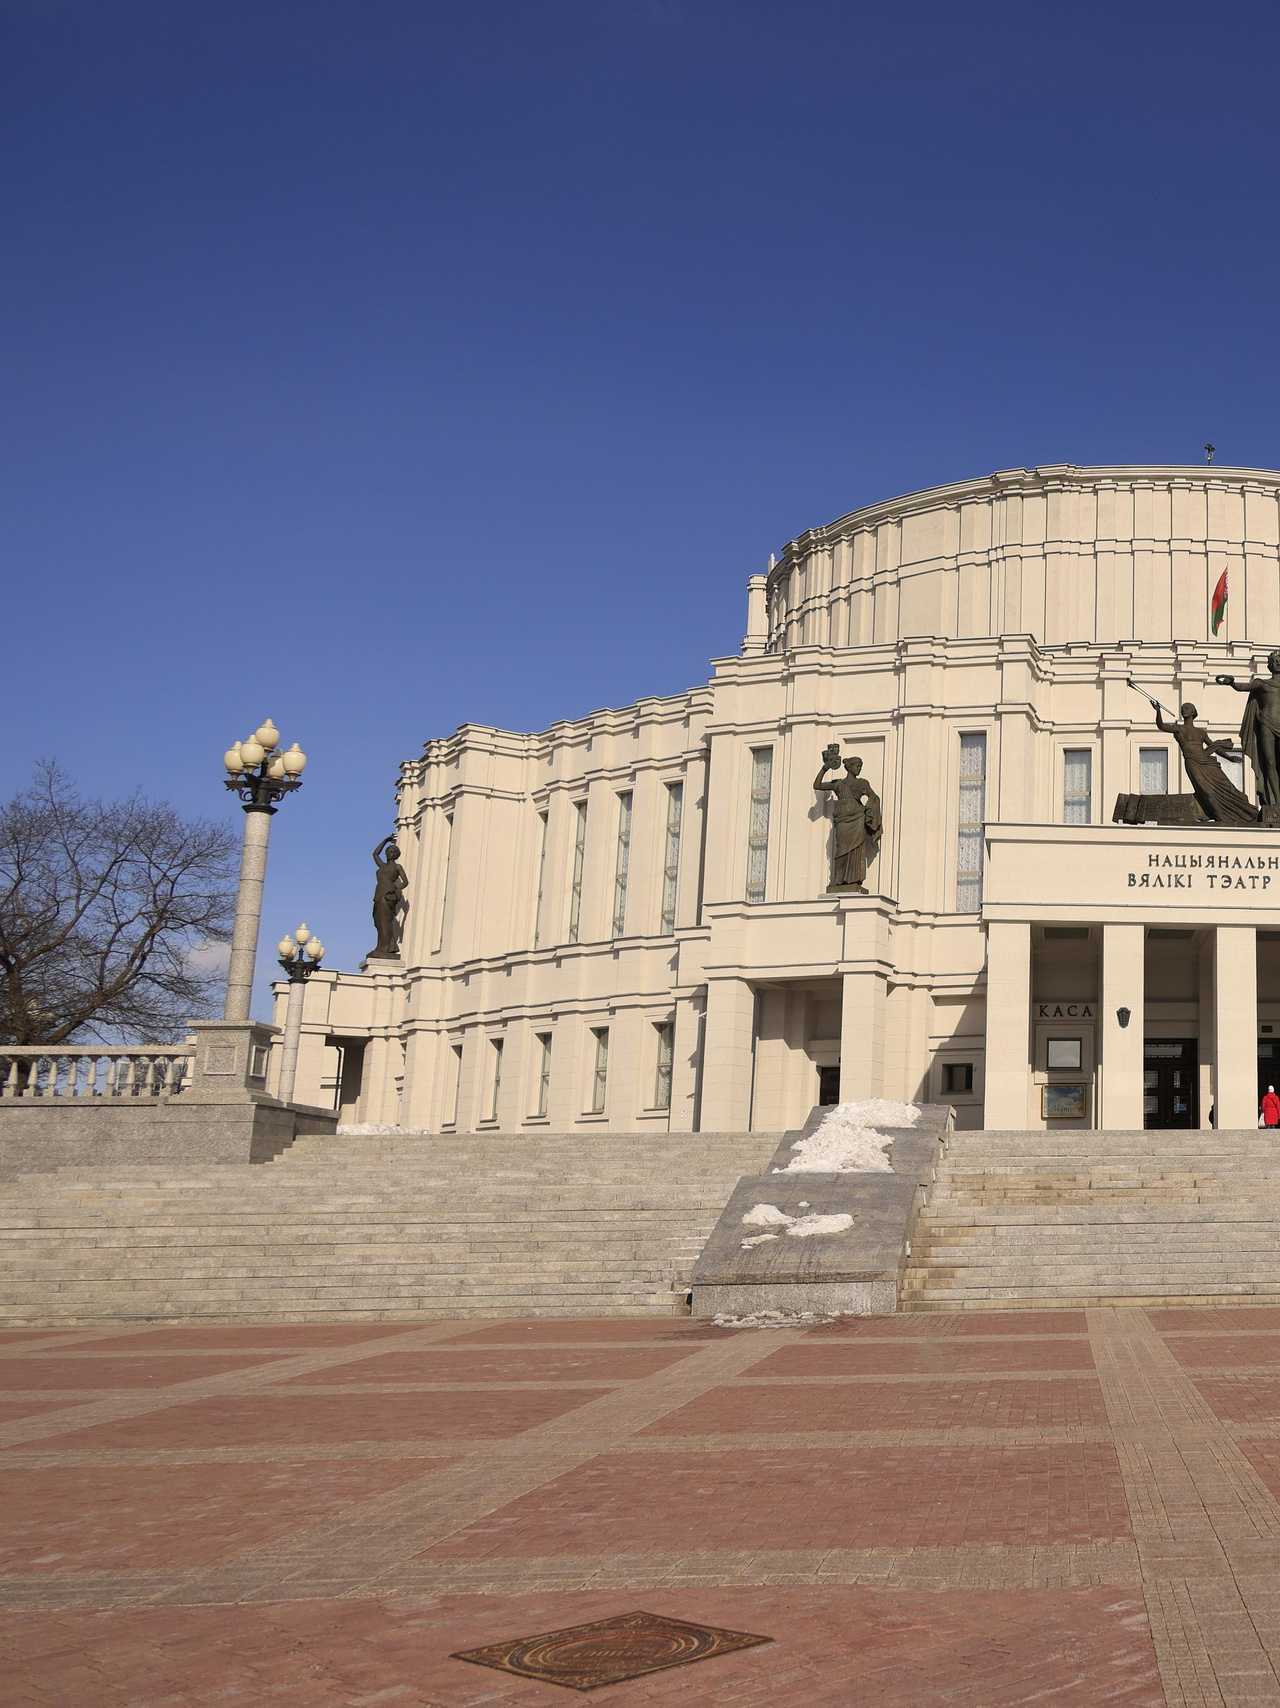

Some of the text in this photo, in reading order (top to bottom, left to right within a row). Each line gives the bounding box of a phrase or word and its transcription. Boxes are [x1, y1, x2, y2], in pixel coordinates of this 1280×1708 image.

[1127, 873, 1192, 888] ВЯЛІКІ
[1206, 874, 1271, 889] ТЭАТР
[1038, 1004, 1094, 1018] КАСА
